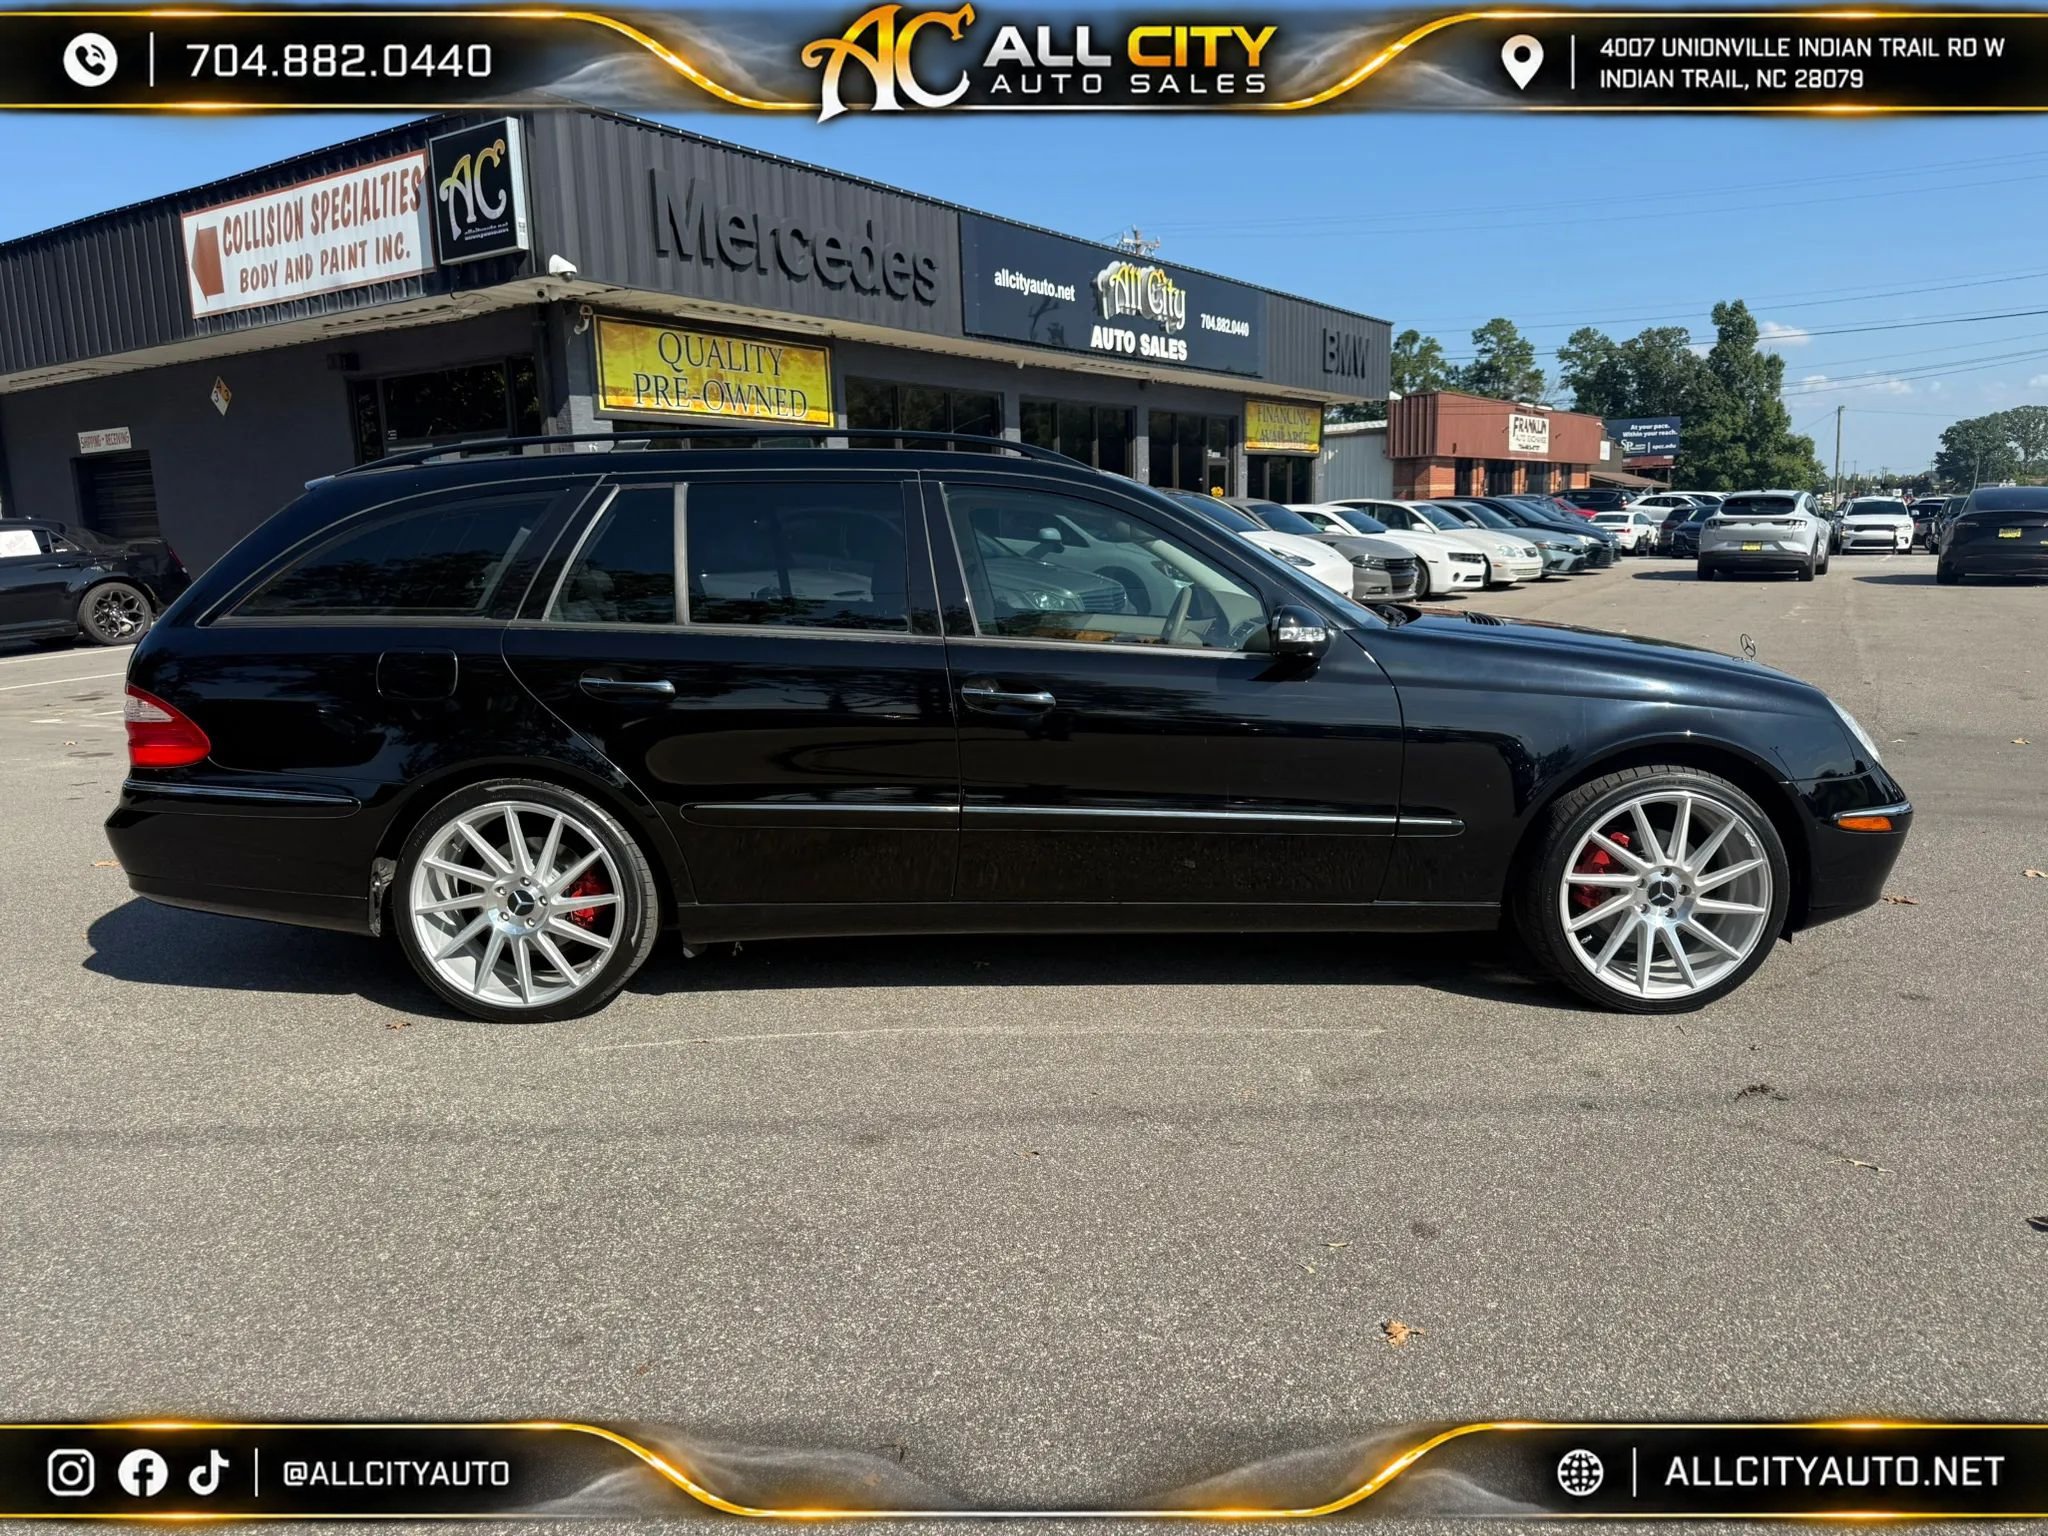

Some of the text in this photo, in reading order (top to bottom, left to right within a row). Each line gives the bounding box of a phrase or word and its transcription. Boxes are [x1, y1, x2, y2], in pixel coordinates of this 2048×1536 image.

[222, 165, 422, 257] COLLISION SPECIALTIES
[439, 138, 507, 241] AC
[649, 167, 939, 307] Mercedes
[240, 231, 411, 293] BODY AND PAINT INC.
[994, 268, 1076, 302] allcityauto.net
[1106, 263, 1186, 331] All City
[1090, 325, 1188, 361] AUTO SALES
[1200, 313, 1250, 337] 704.882.0440
[658, 332, 784, 377] QUALITY
[1323, 328, 1370, 379] BMW
[633, 372, 807, 418] PRE-OWNED
[1258, 404, 1311, 426] FINANCING
[1513, 416, 1547, 437] FRANKLIN
